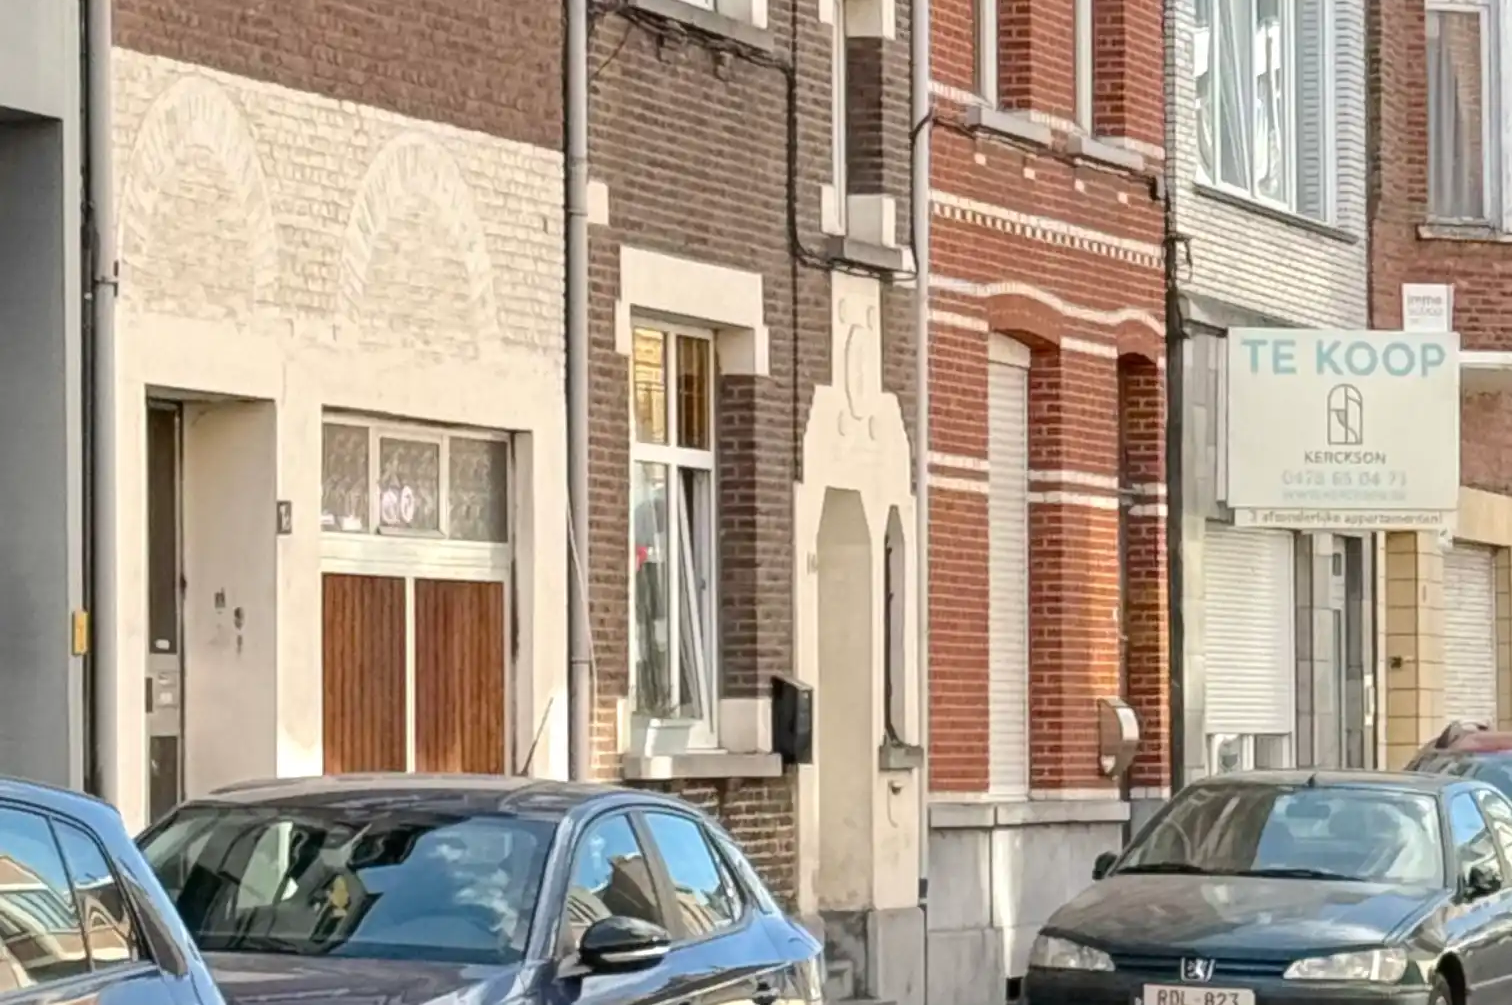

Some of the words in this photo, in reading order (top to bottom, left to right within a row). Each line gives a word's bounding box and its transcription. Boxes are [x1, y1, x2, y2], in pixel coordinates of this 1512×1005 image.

[1241, 339, 1297, 375] TE
[1316, 340, 1446, 377] KOOP
[1304, 451, 1387, 465] KERCKSON
